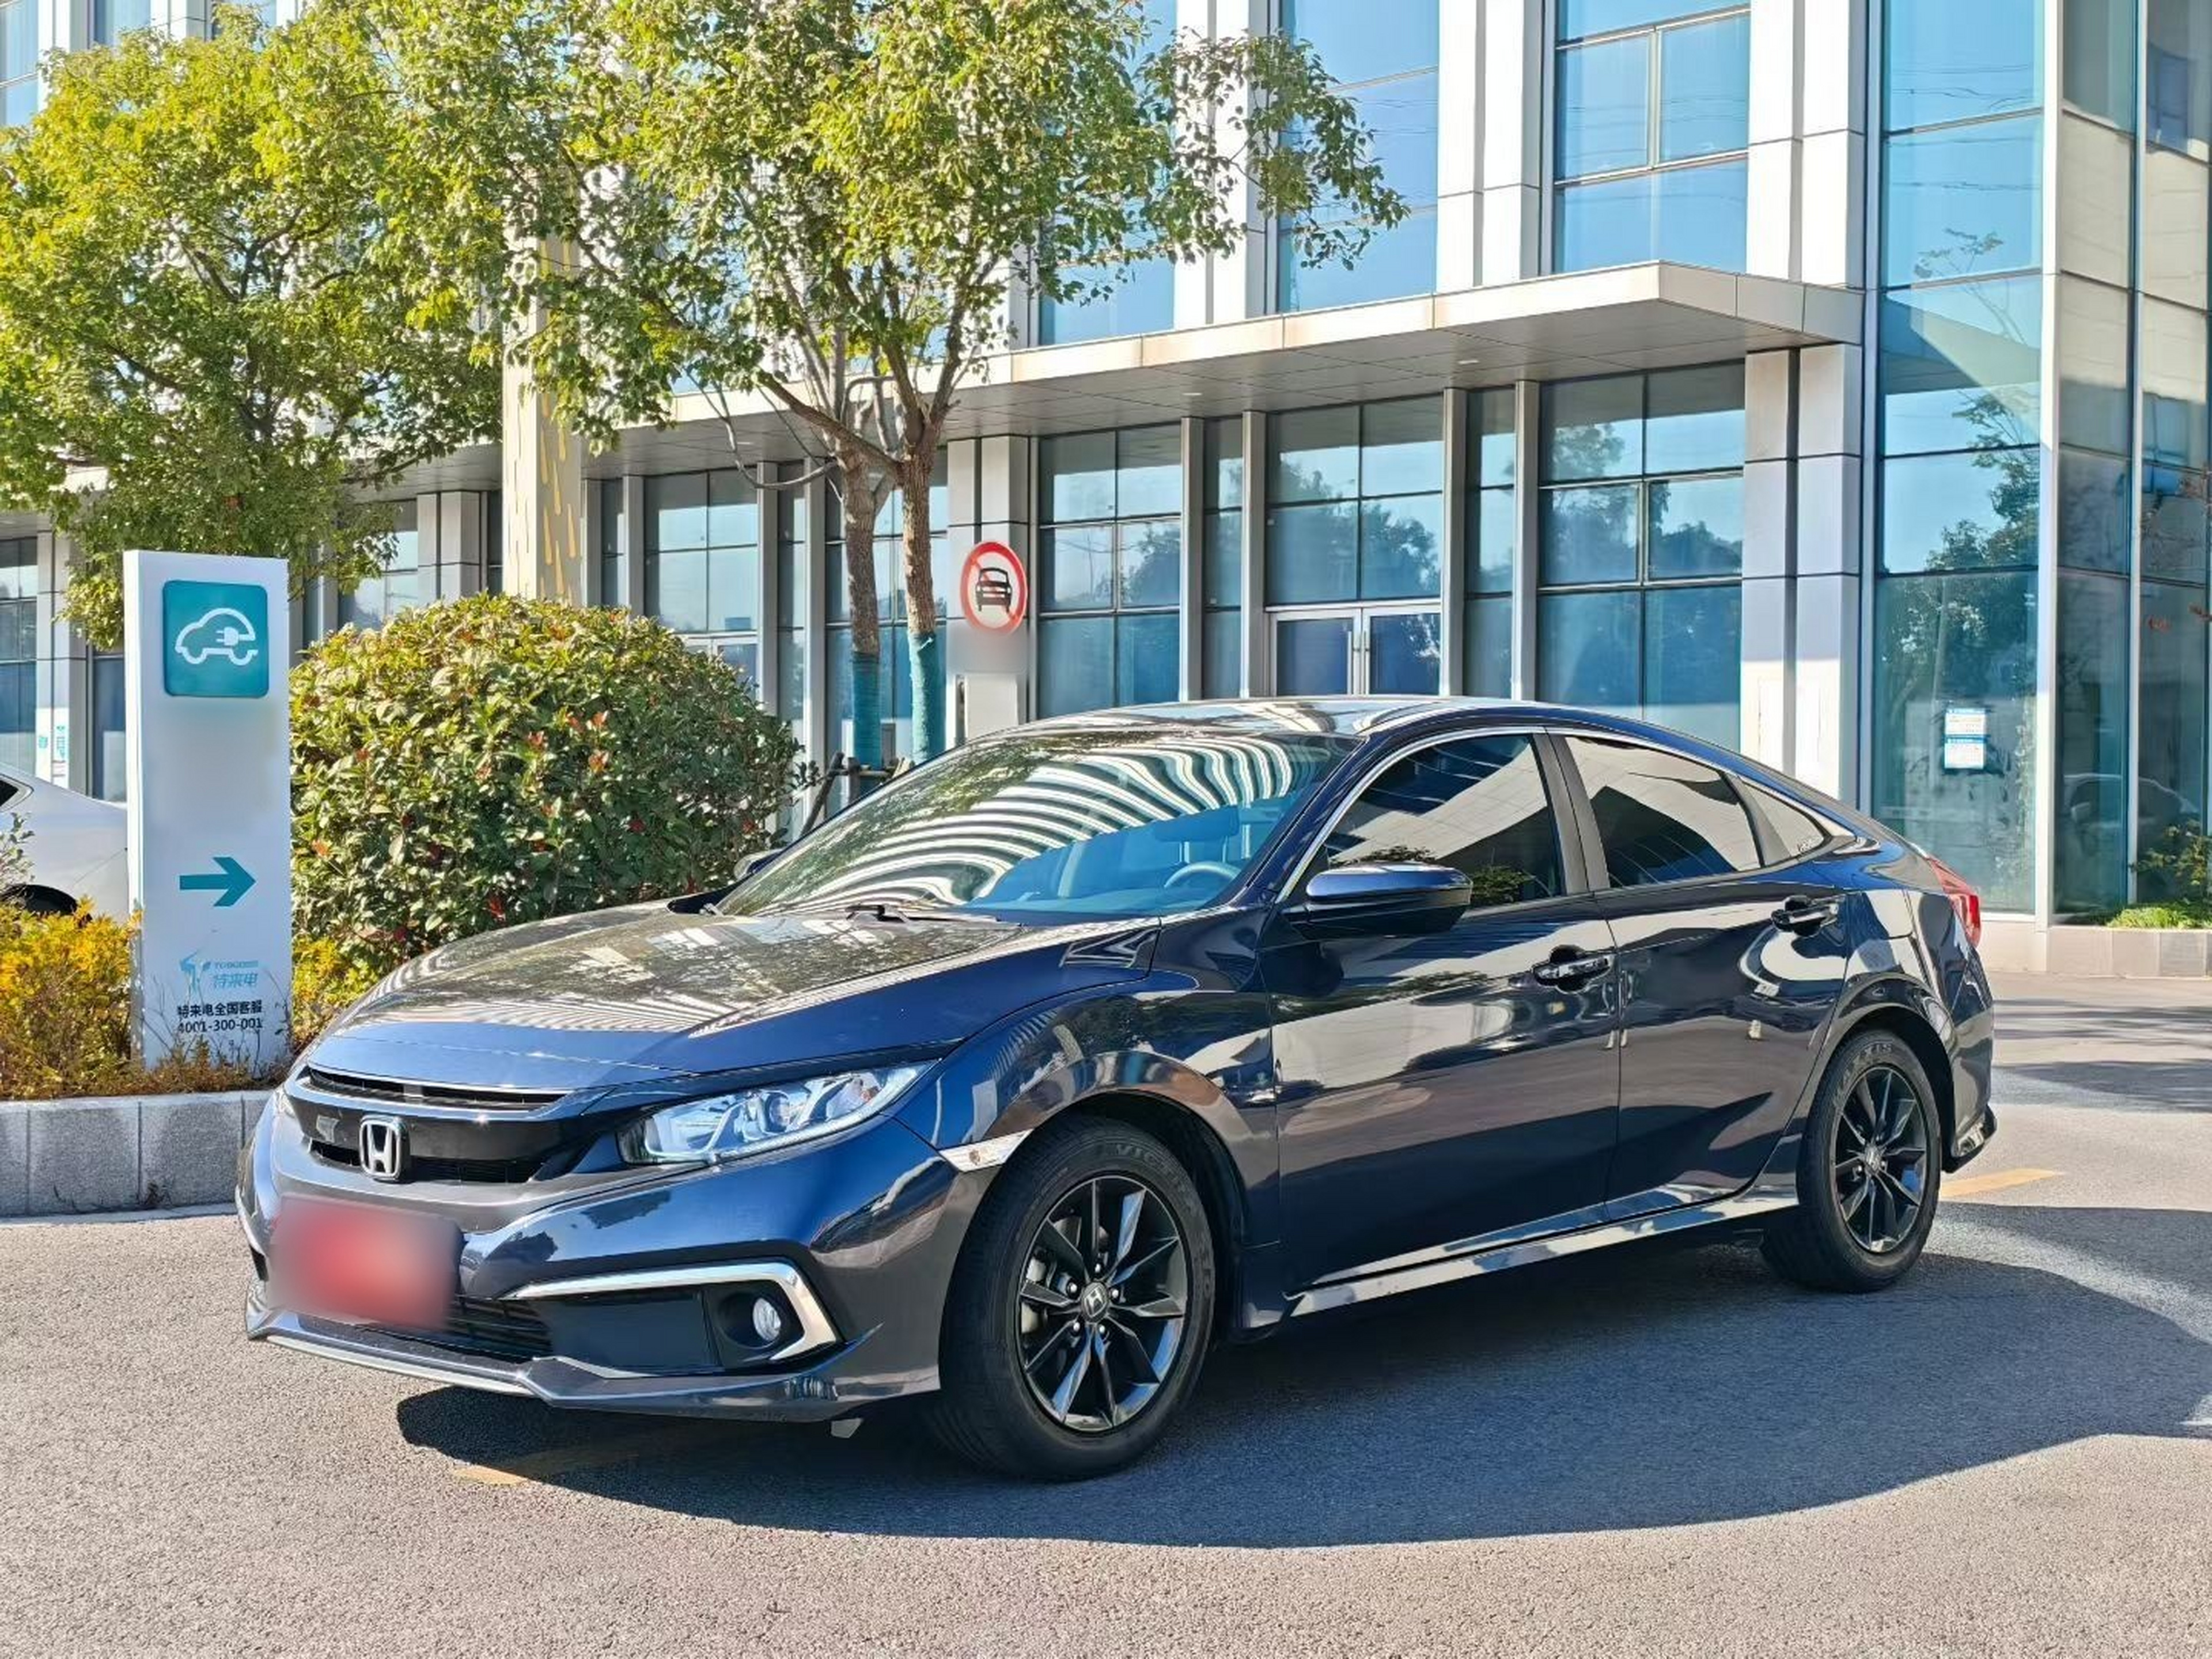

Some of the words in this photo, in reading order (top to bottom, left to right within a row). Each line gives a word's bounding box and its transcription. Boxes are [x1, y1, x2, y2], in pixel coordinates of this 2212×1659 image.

[177, 1000, 262, 1018] 特来电全国客服
[178, 1017, 263, 1033] 4001-300-001
